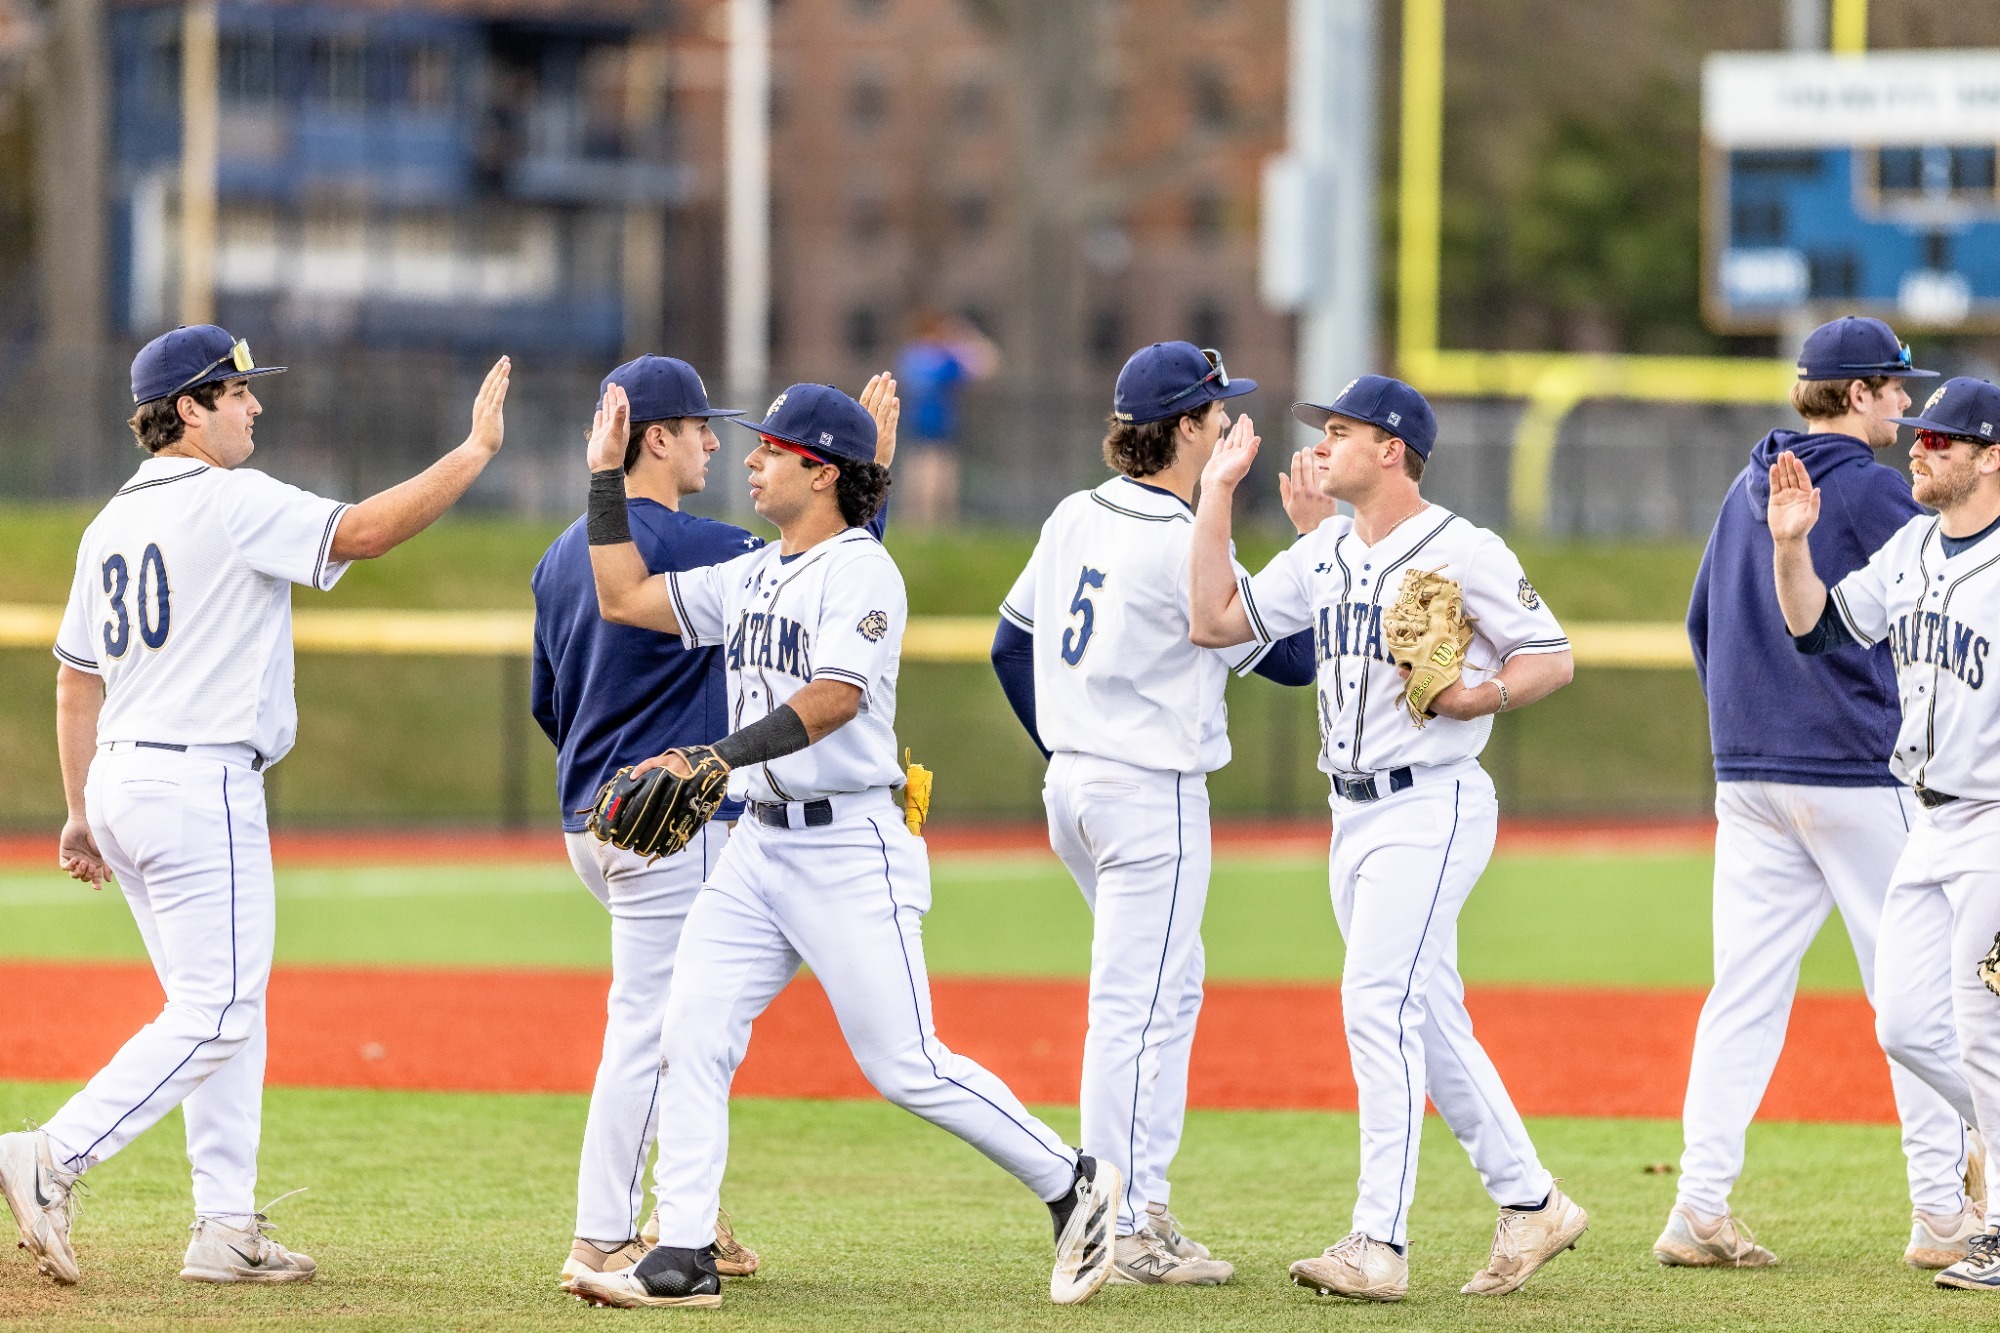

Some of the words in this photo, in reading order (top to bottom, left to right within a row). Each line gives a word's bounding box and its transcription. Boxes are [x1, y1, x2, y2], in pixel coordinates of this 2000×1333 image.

[102, 541, 174, 662] 30
[1061, 563, 1109, 669] 5
[1313, 602, 1396, 666] ANTA
